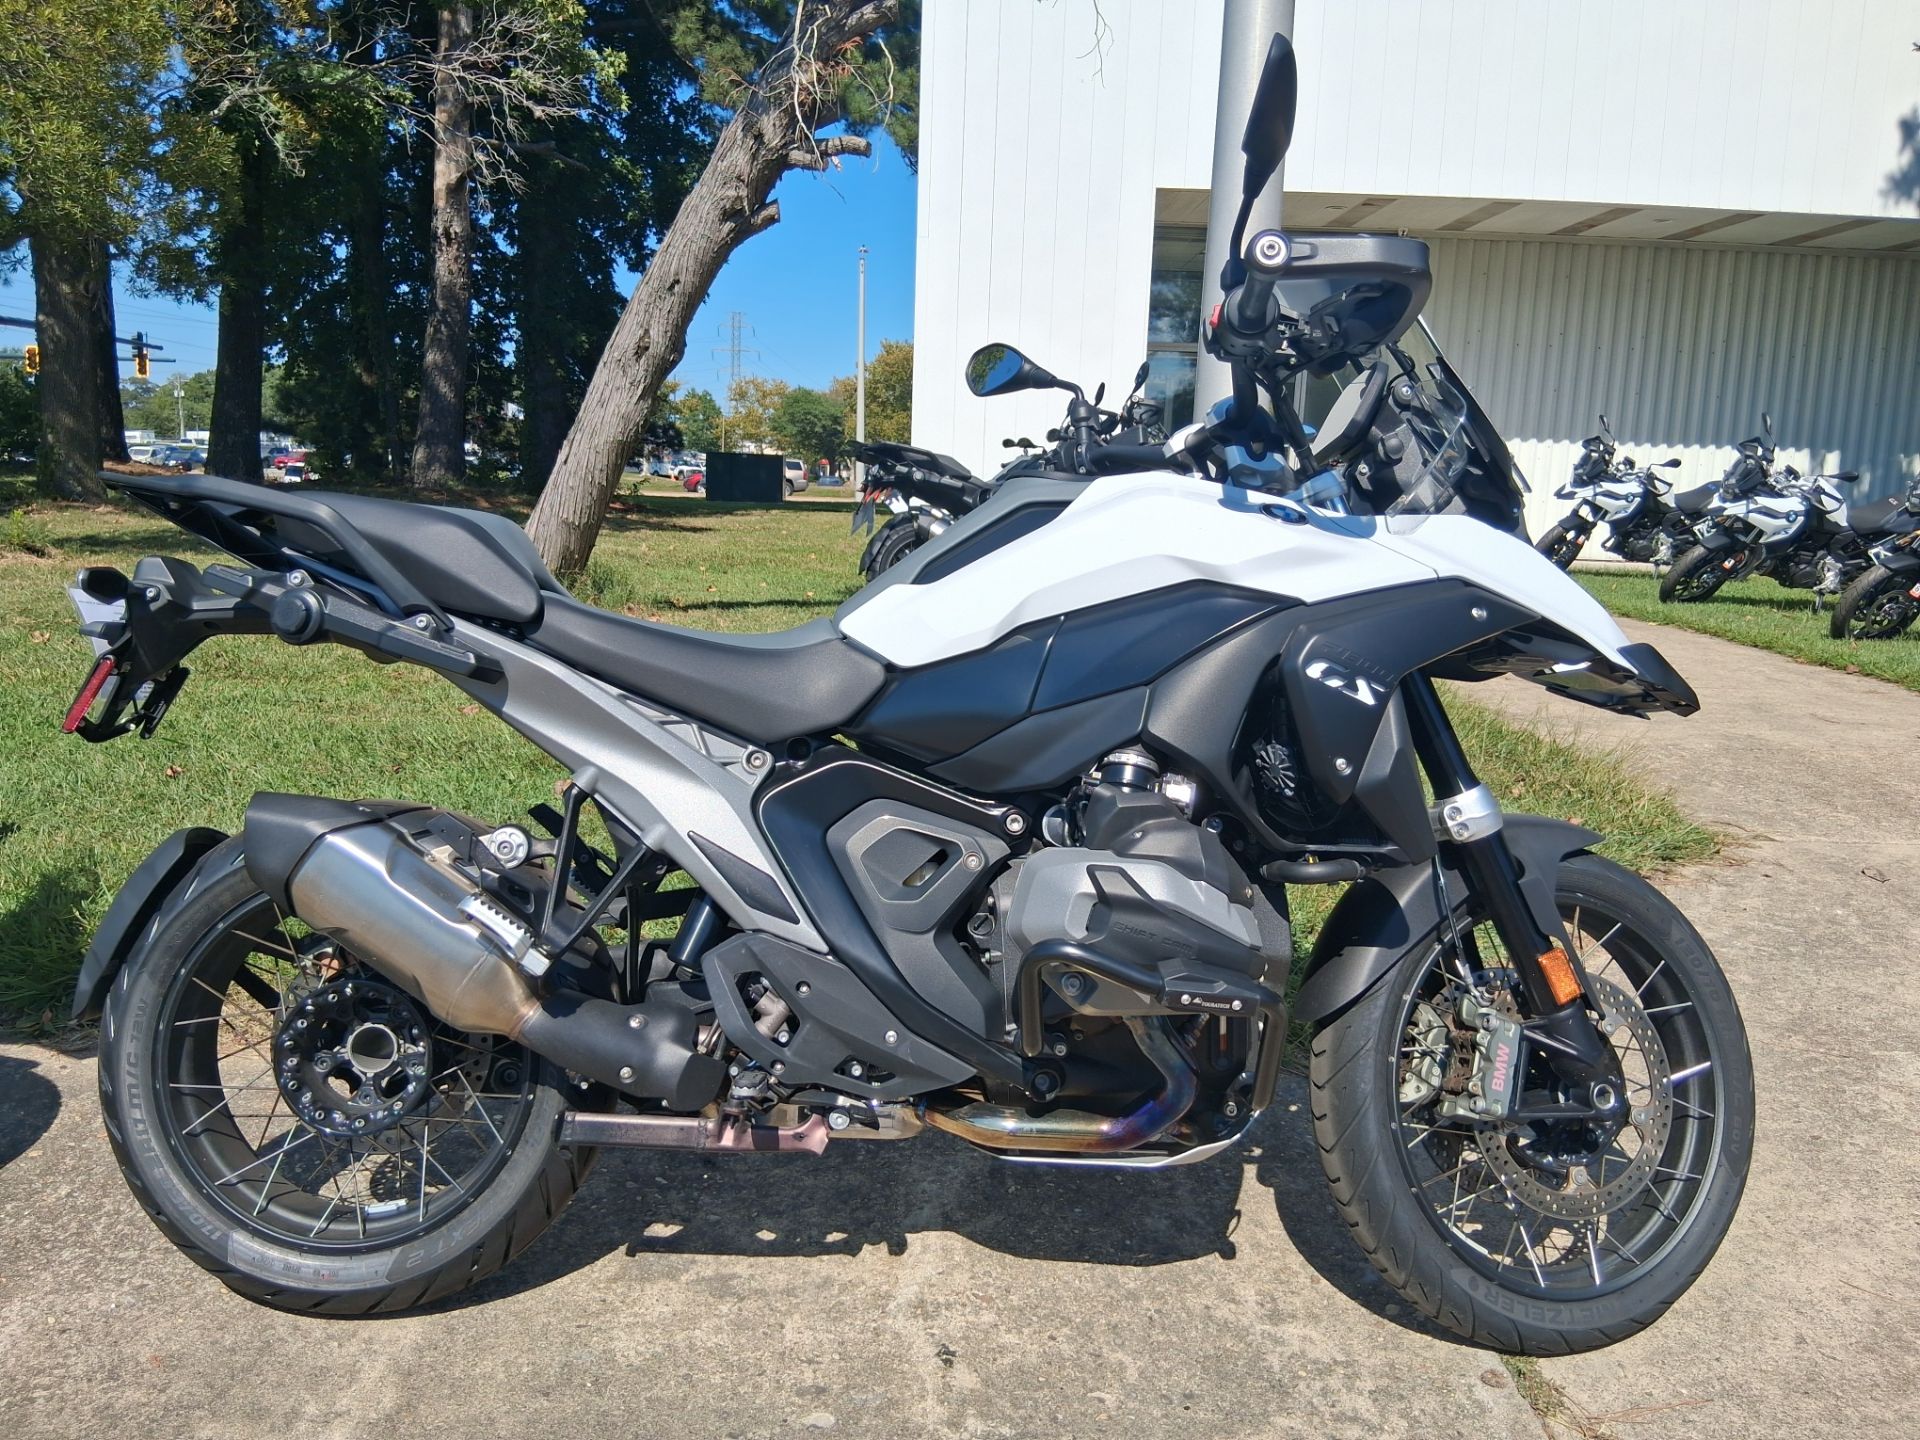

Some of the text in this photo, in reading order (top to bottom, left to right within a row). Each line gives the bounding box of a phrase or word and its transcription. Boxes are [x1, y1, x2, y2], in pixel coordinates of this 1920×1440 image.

[1305, 657, 1390, 706] GS
[1113, 920, 1156, 941] SHIFT
[129, 998, 149, 1044] 72W
[1201, 1002, 1230, 1010] TOURATECH
[126, 1051, 143, 1111] M/C
[1492, 1042, 1511, 1093] BMW
[1483, 1286, 1616, 1326] METZELER
